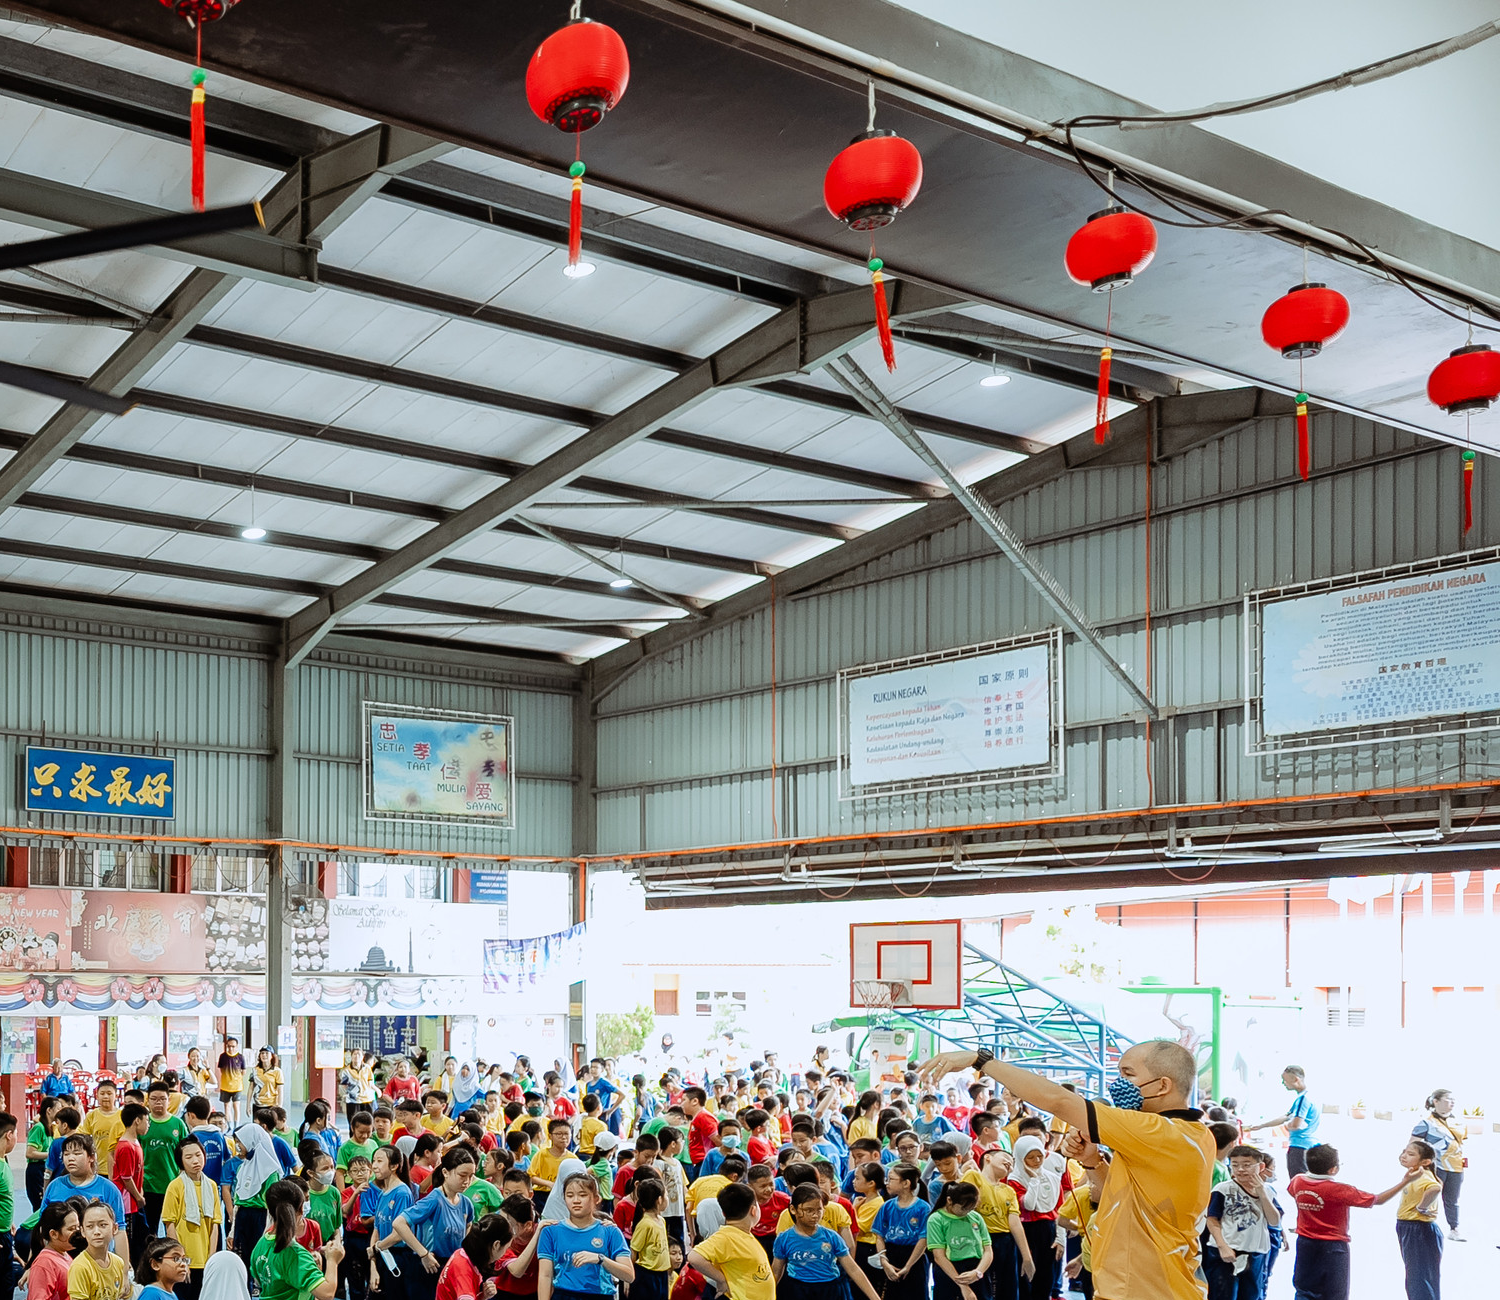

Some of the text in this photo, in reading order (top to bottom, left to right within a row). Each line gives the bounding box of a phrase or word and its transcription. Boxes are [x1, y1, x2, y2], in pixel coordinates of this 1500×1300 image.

[1342, 572, 1487, 607] FALSAFAH PENDIDIKAN NEGARA
[978, 667, 1029, 686] 国家原则
[873, 685, 927, 703] RUKUN NEGARA
[379, 722, 397, 740] 忠
[377, 743, 405, 752] SETIA
[413, 742, 430, 760] 孝
[407, 761, 432, 771] TAAT
[440, 763, 458, 780] 仁
[30, 761, 173, 808] 只求最好
[437, 783, 466, 793] MULIA
[476, 783, 492, 800] 爱
[466, 802, 503, 812] SAYANG
[14, 906, 34, 918] NEW
[36, 908, 59, 918] YEAR
[332, 903, 364, 917] Selamat
